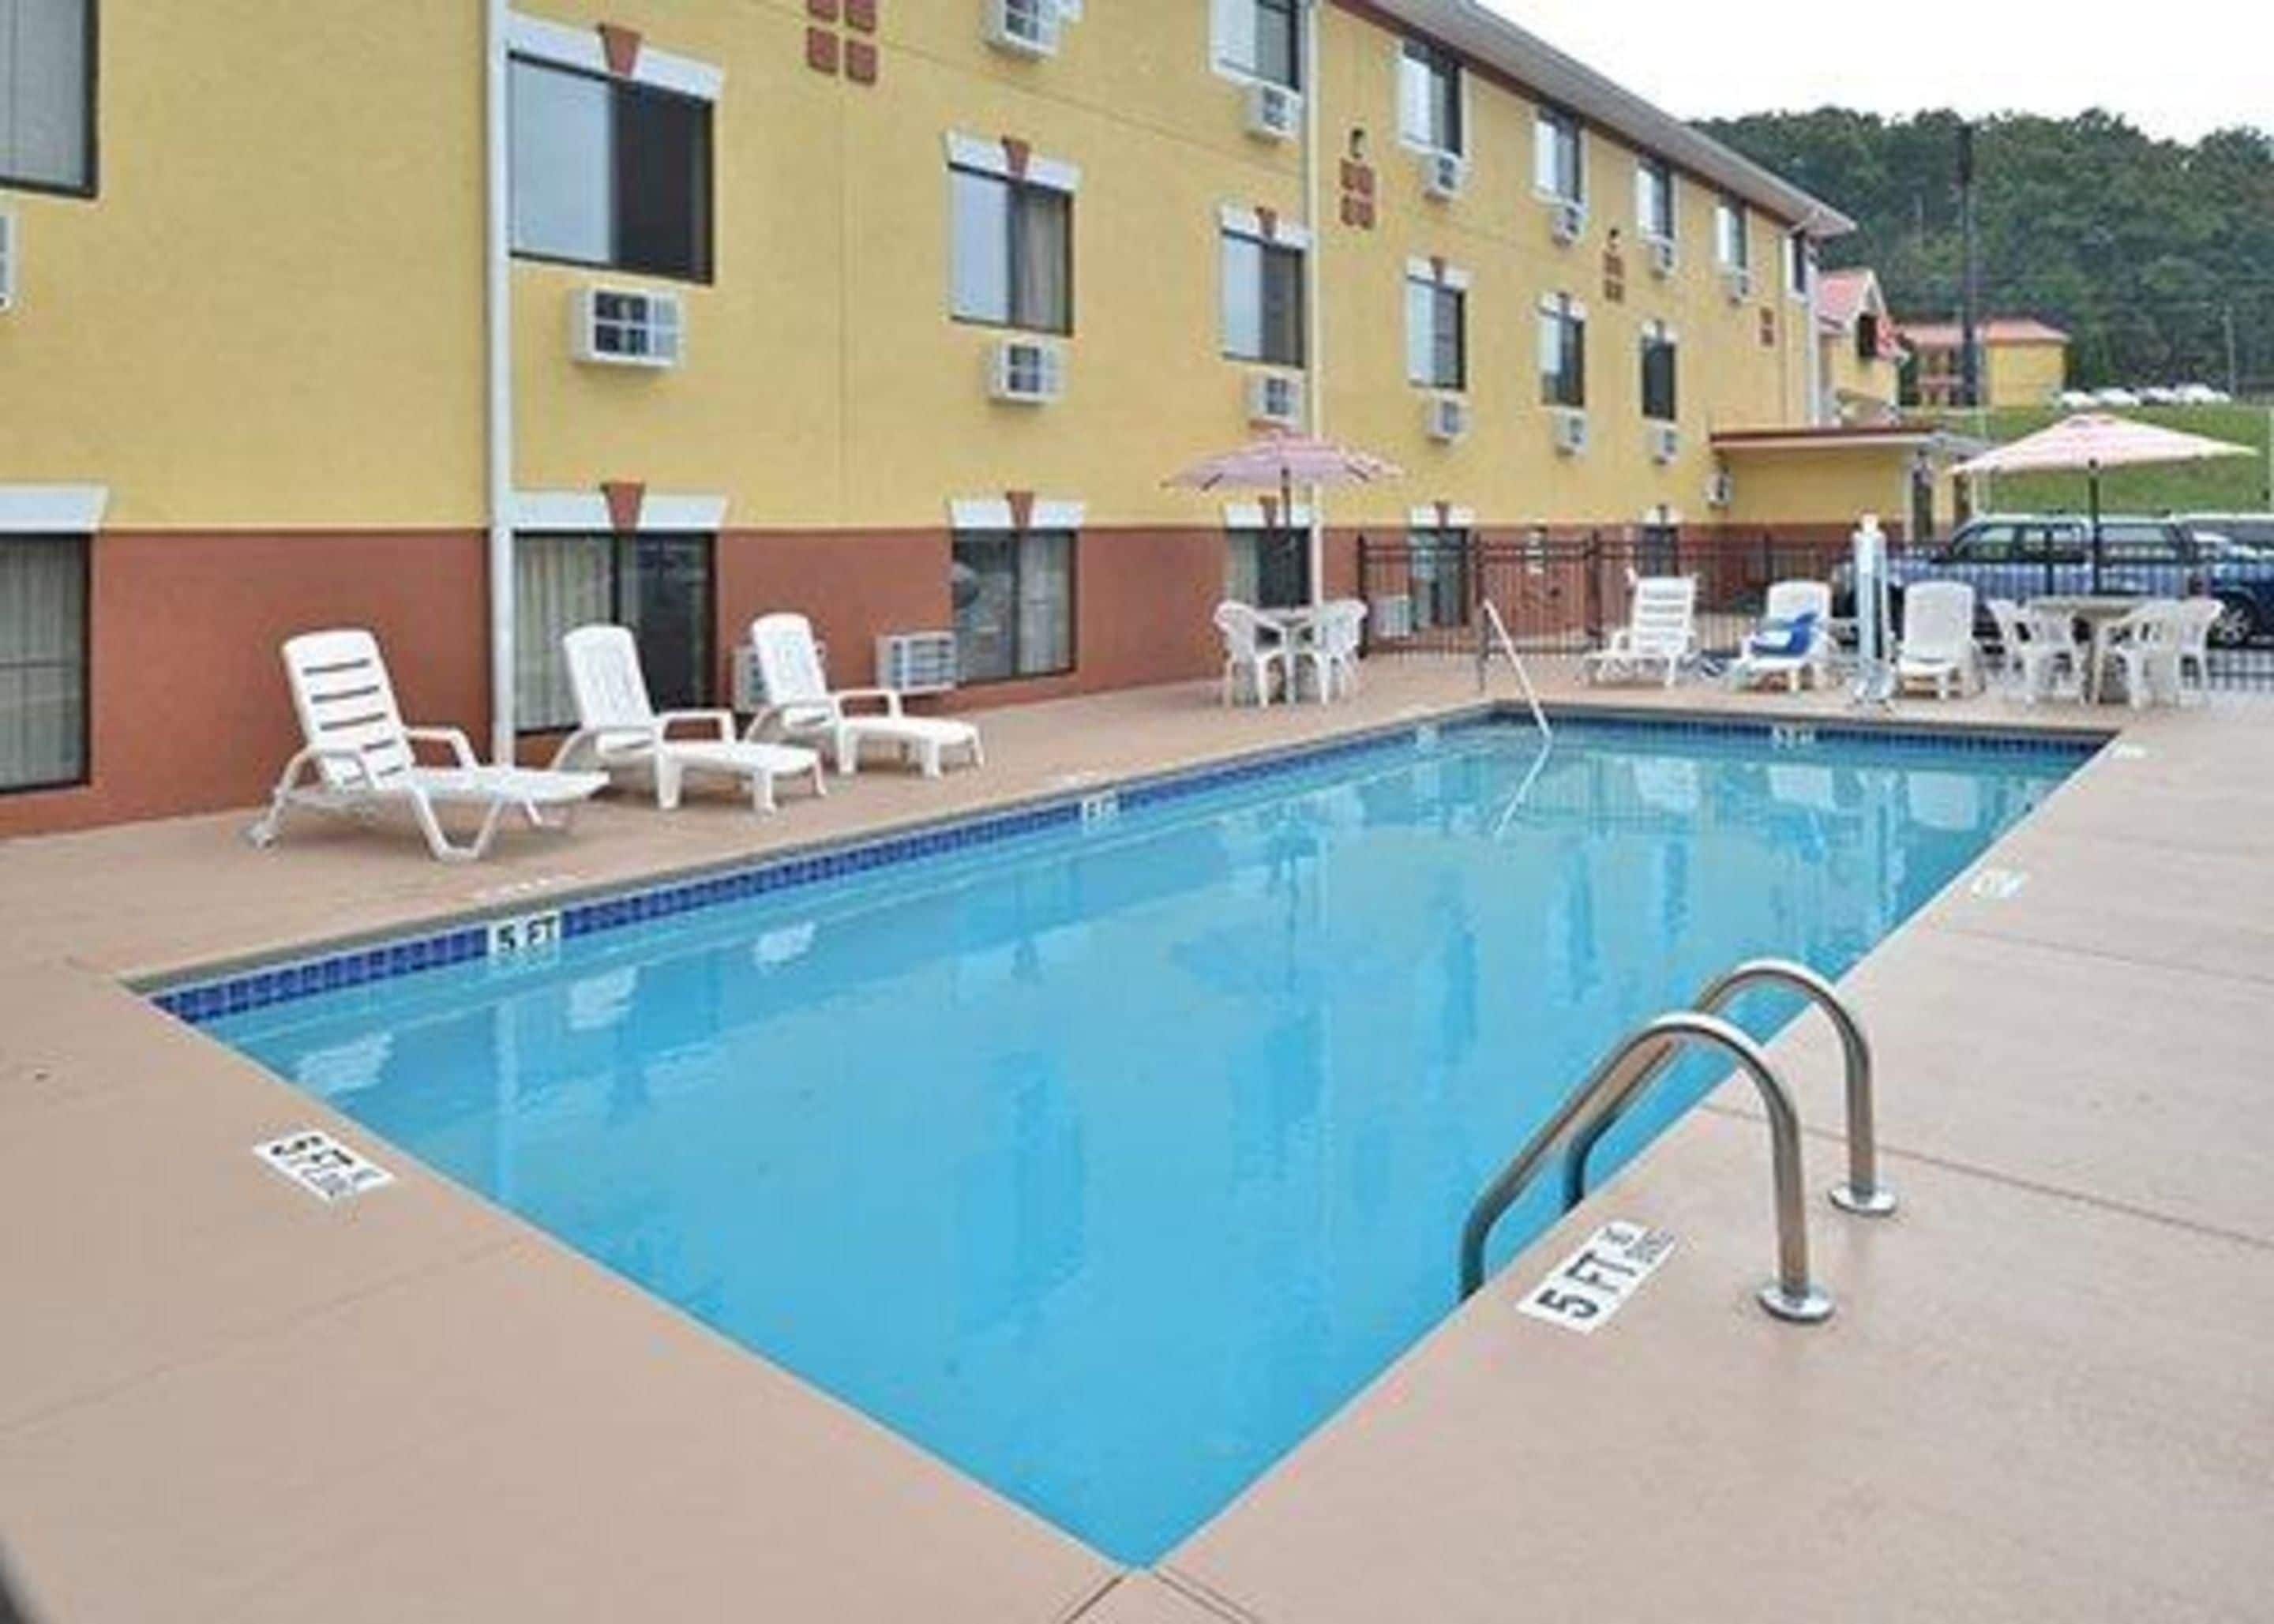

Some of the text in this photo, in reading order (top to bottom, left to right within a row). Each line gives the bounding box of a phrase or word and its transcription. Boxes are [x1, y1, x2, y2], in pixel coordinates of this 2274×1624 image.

[497, 914, 556, 952] 5 FT
[1537, 1250, 1636, 1318] 5 FT
